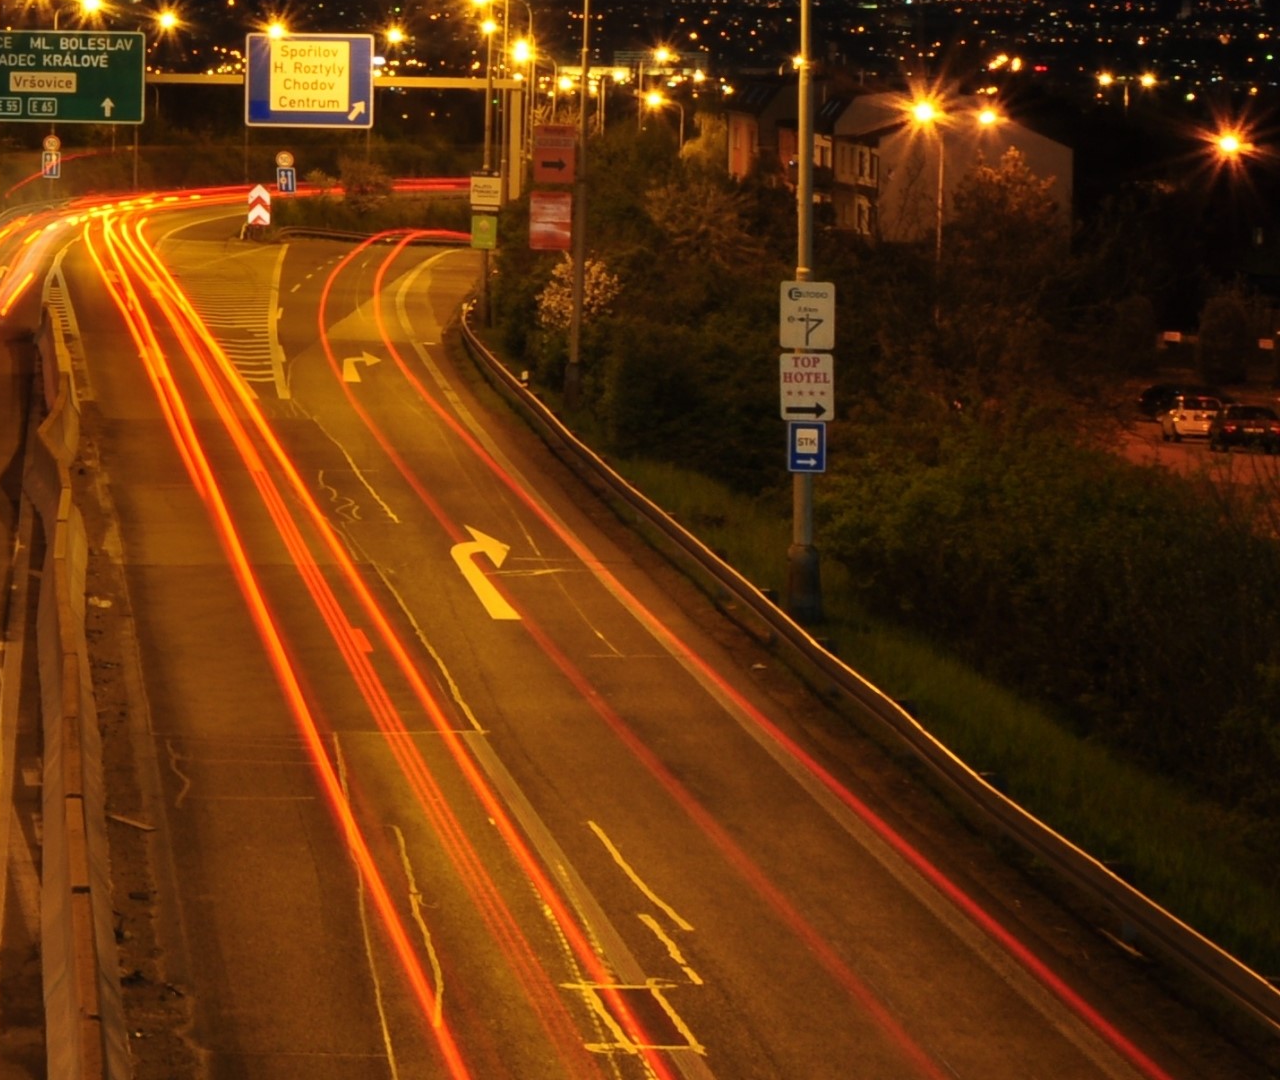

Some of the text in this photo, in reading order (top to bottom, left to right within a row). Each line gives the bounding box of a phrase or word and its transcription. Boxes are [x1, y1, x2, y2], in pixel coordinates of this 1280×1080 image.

[30, 37, 54, 50] ML.
[60, 37, 133, 51] BOLESLAV
[280, 45, 339, 60] Spořilov
[42, 51, 109, 68] KRÁLOVÉ
[274, 62, 344, 77] H. Roztyly
[13, 75, 73, 89] Vršovice
[283, 79, 335, 91] Chodov
[6, 100, 18, 112] 55
[32, 101, 53, 112] E 65
[279, 96, 340, 108] Centrum
[792, 356, 820, 368] TOP
[783, 371, 830, 384] HOTEL
[797, 437, 817, 447] STK
